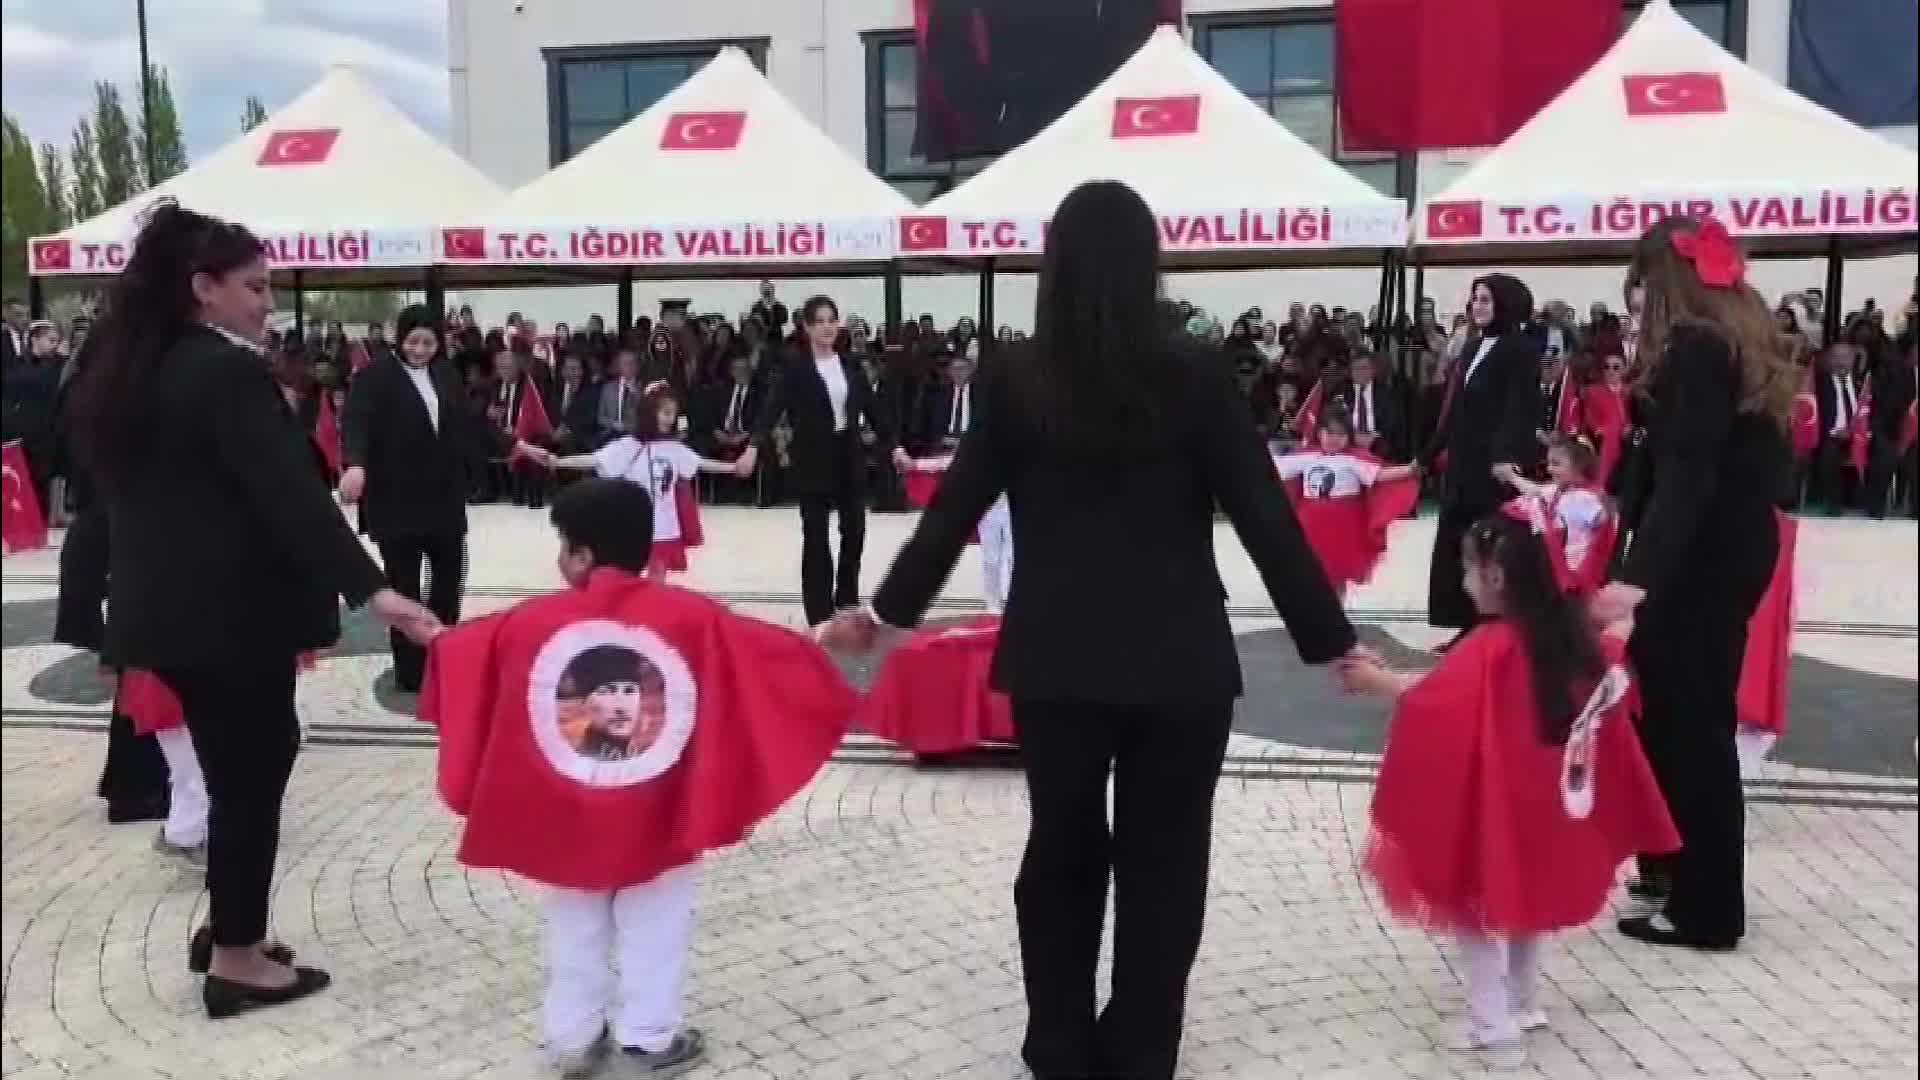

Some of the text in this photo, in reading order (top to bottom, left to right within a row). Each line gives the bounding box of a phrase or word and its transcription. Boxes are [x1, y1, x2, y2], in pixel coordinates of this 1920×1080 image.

[962, 221, 1028, 248] T.C.
[1160, 207, 1331, 243] VALİLİĞİ
[1500, 206, 1576, 234] T.C.
[1729, 187, 1918, 229] VALİLİĞ
[80, 243, 126, 269] T.C
[257, 230, 369, 262] ALİLİĞİ
[498, 233, 558, 259] T.C.
[570, 226, 664, 258] IĞDIR
[674, 222, 825, 256] VALİLİĞİ
